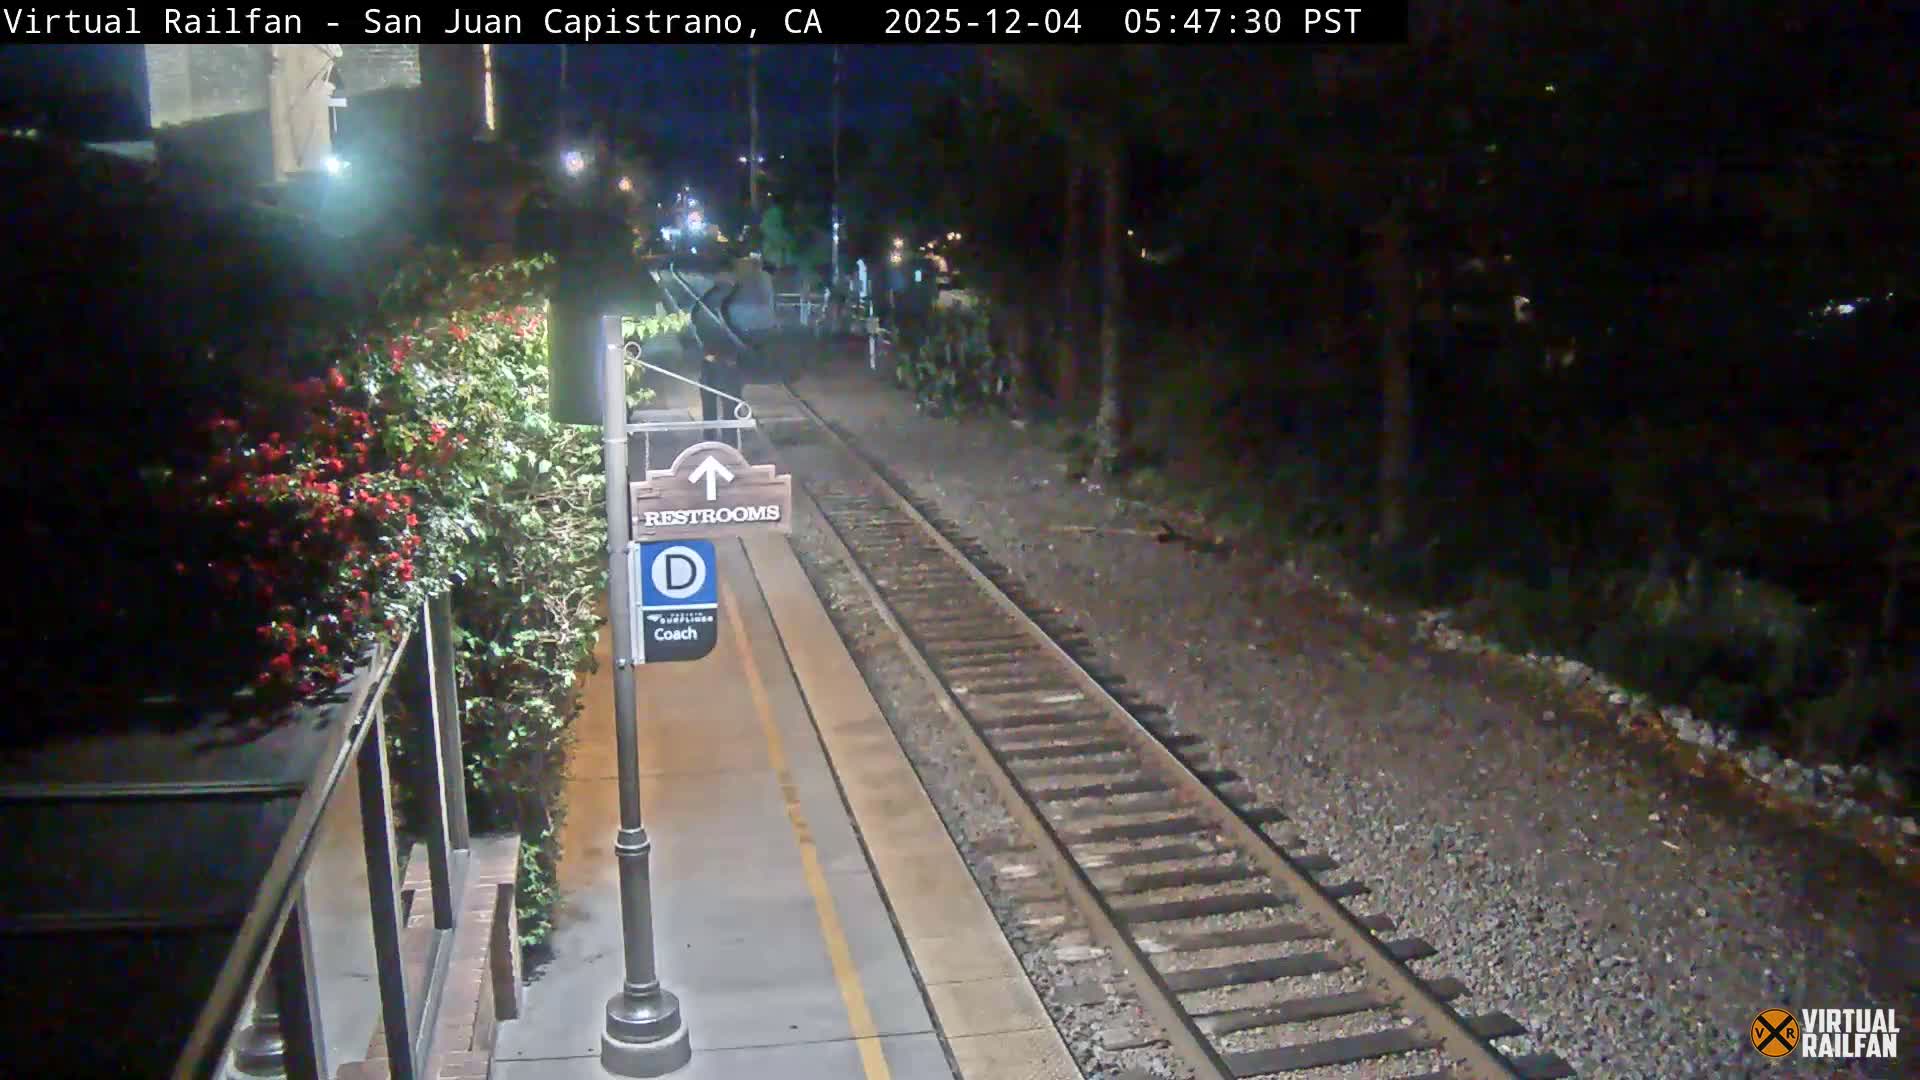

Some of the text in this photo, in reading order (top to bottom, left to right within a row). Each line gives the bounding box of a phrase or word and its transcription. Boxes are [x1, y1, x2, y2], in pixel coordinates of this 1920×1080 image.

[643, 504, 781, 528] RESTROOMS
[665, 554, 697, 590] D
[654, 625, 698, 641] Coach
